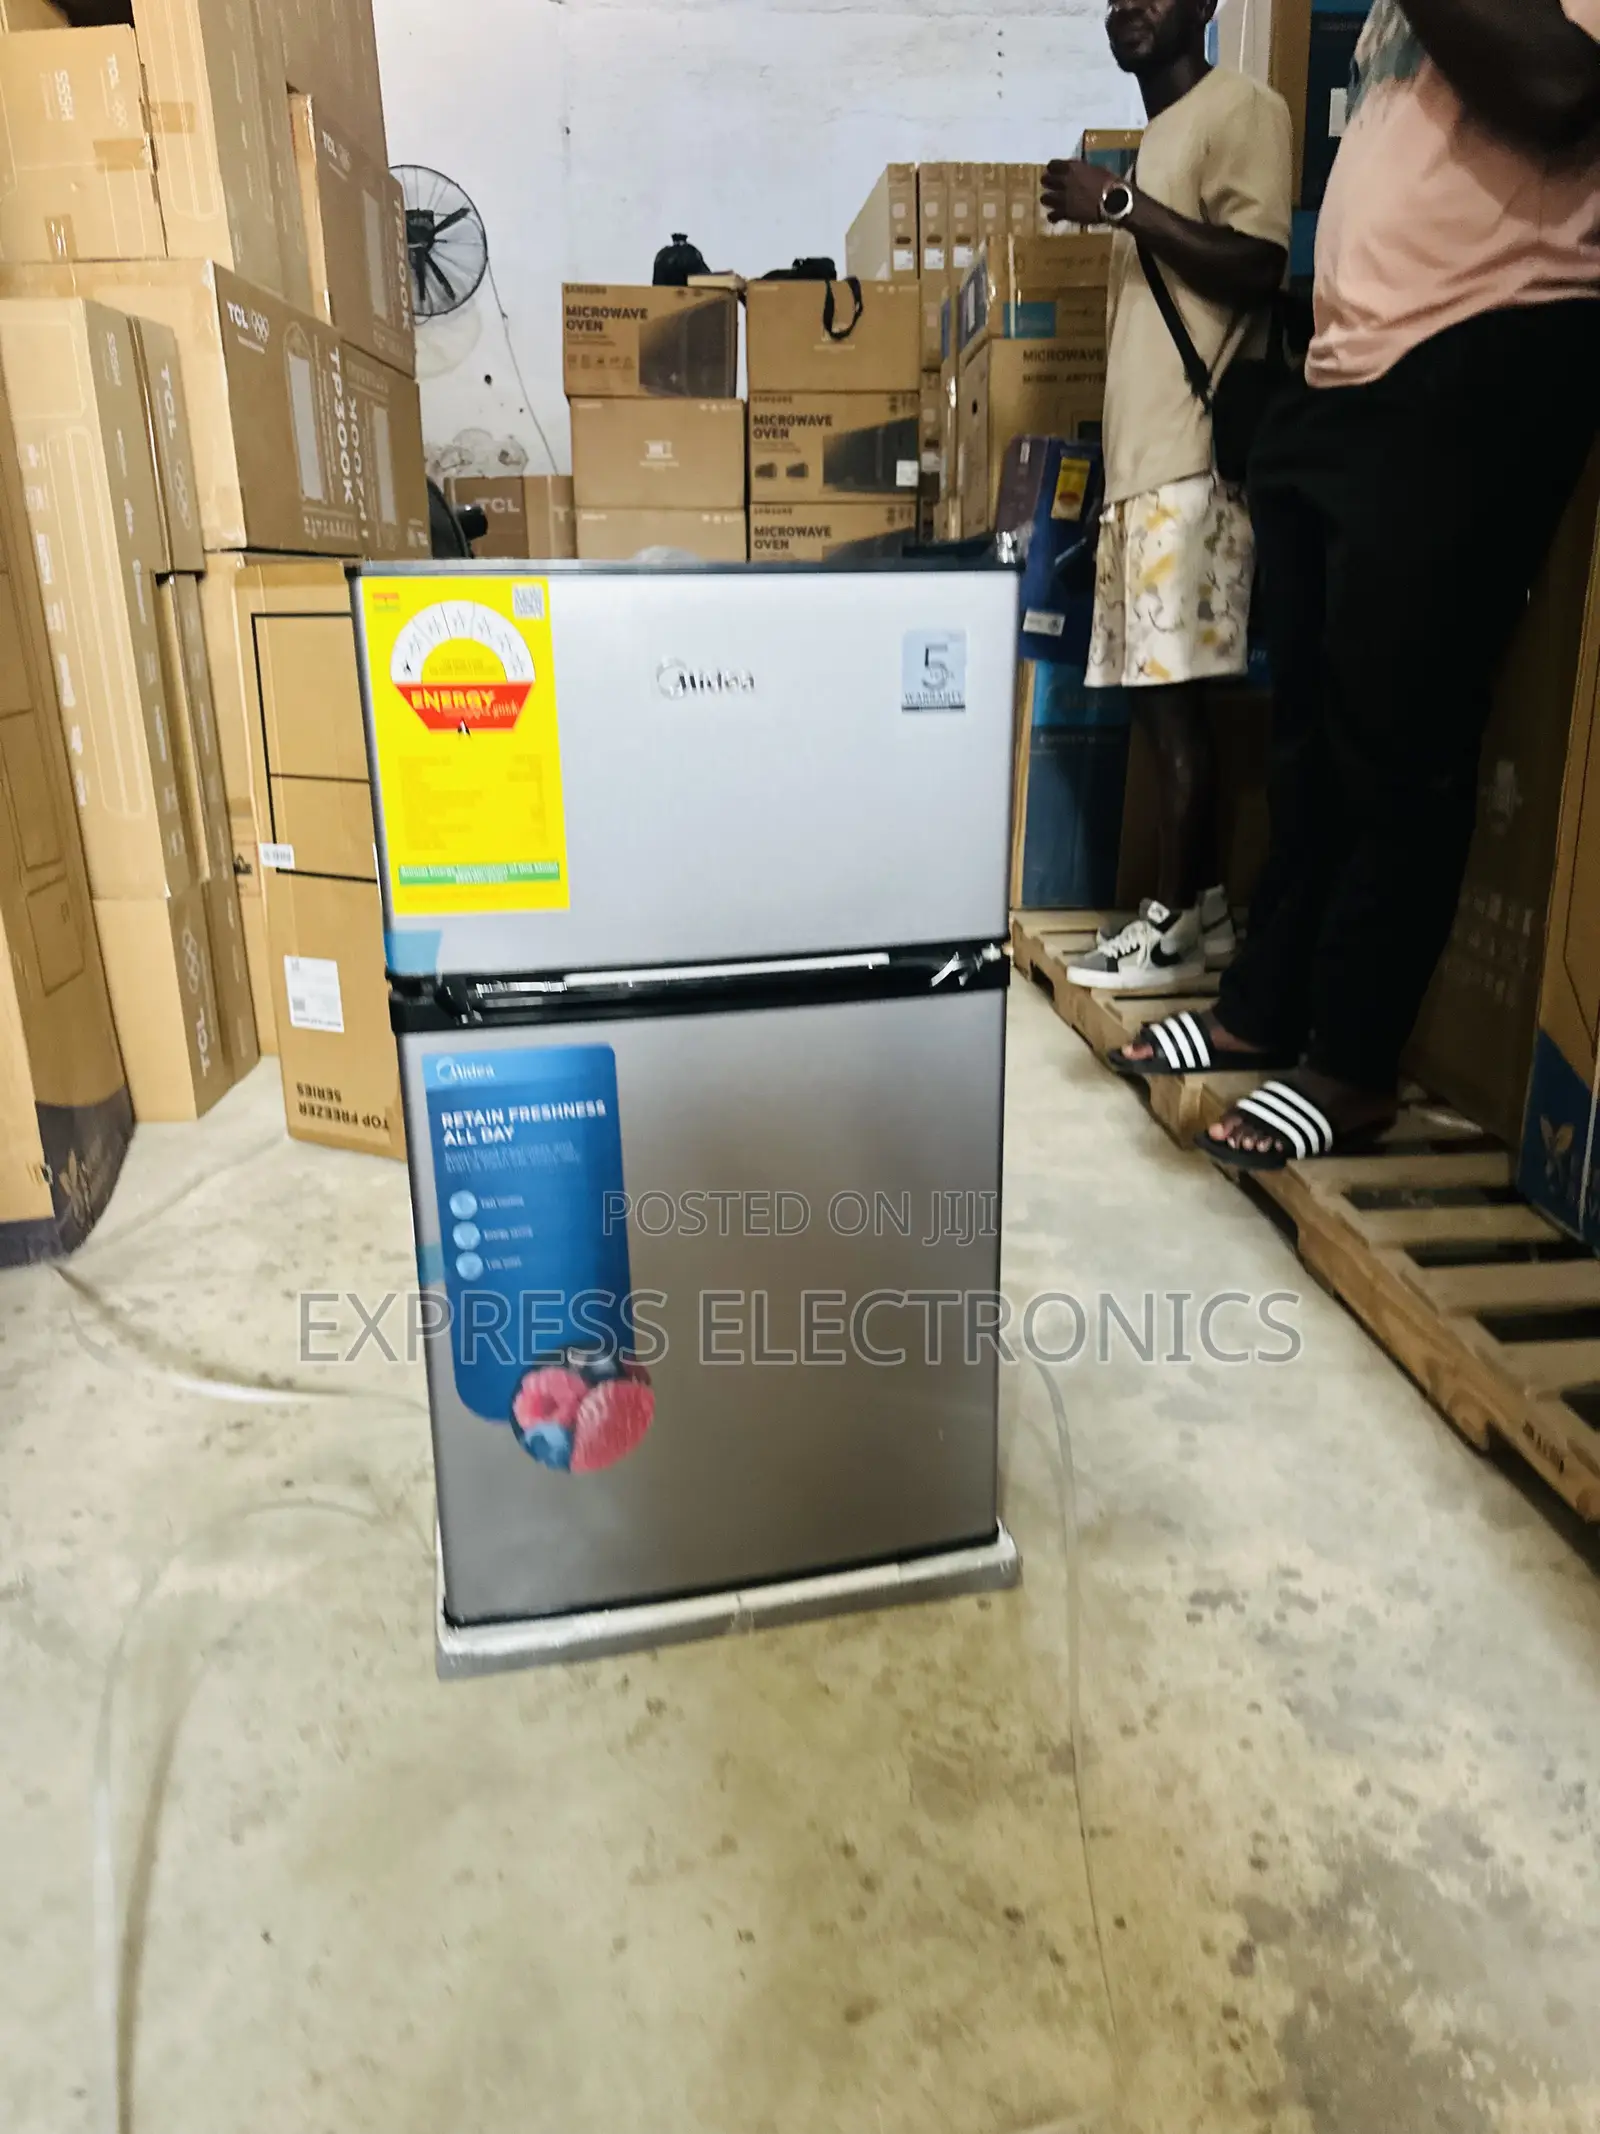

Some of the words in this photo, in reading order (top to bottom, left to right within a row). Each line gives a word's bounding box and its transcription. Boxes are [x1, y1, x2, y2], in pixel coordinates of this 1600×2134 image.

[107, 53, 120, 89] TCL
[322, 130, 338, 158] TCL
[226, 301, 249, 329] TCL
[565, 305, 648, 320] MICROWAVE
[566, 320, 603, 332] OVEN
[161, 364, 177, 439] TCL
[330, 347, 354, 504] TP300K
[753, 414, 833, 427] MICROWAVE
[753, 428, 789, 439] OVEN
[475, 498, 520, 513] TCL
[754, 525, 832, 538] MICROWAVE
[754, 539, 789, 550] OVEN
[922, 643, 949, 691] 5
[411, 688, 495, 713] ENERGY
[196, 1008, 211, 1077] TCL
[296, 1082, 342, 1102] SERIES
[299, 1103, 359, 1125] FREEZER
[363, 1111, 390, 1132] TOP
[441, 1107, 504, 1129] RETAIN
[509, 1099, 606, 1124] FRESHNESS
[443, 1128, 478, 1147] ALL
[481, 1125, 515, 1144] DAY
